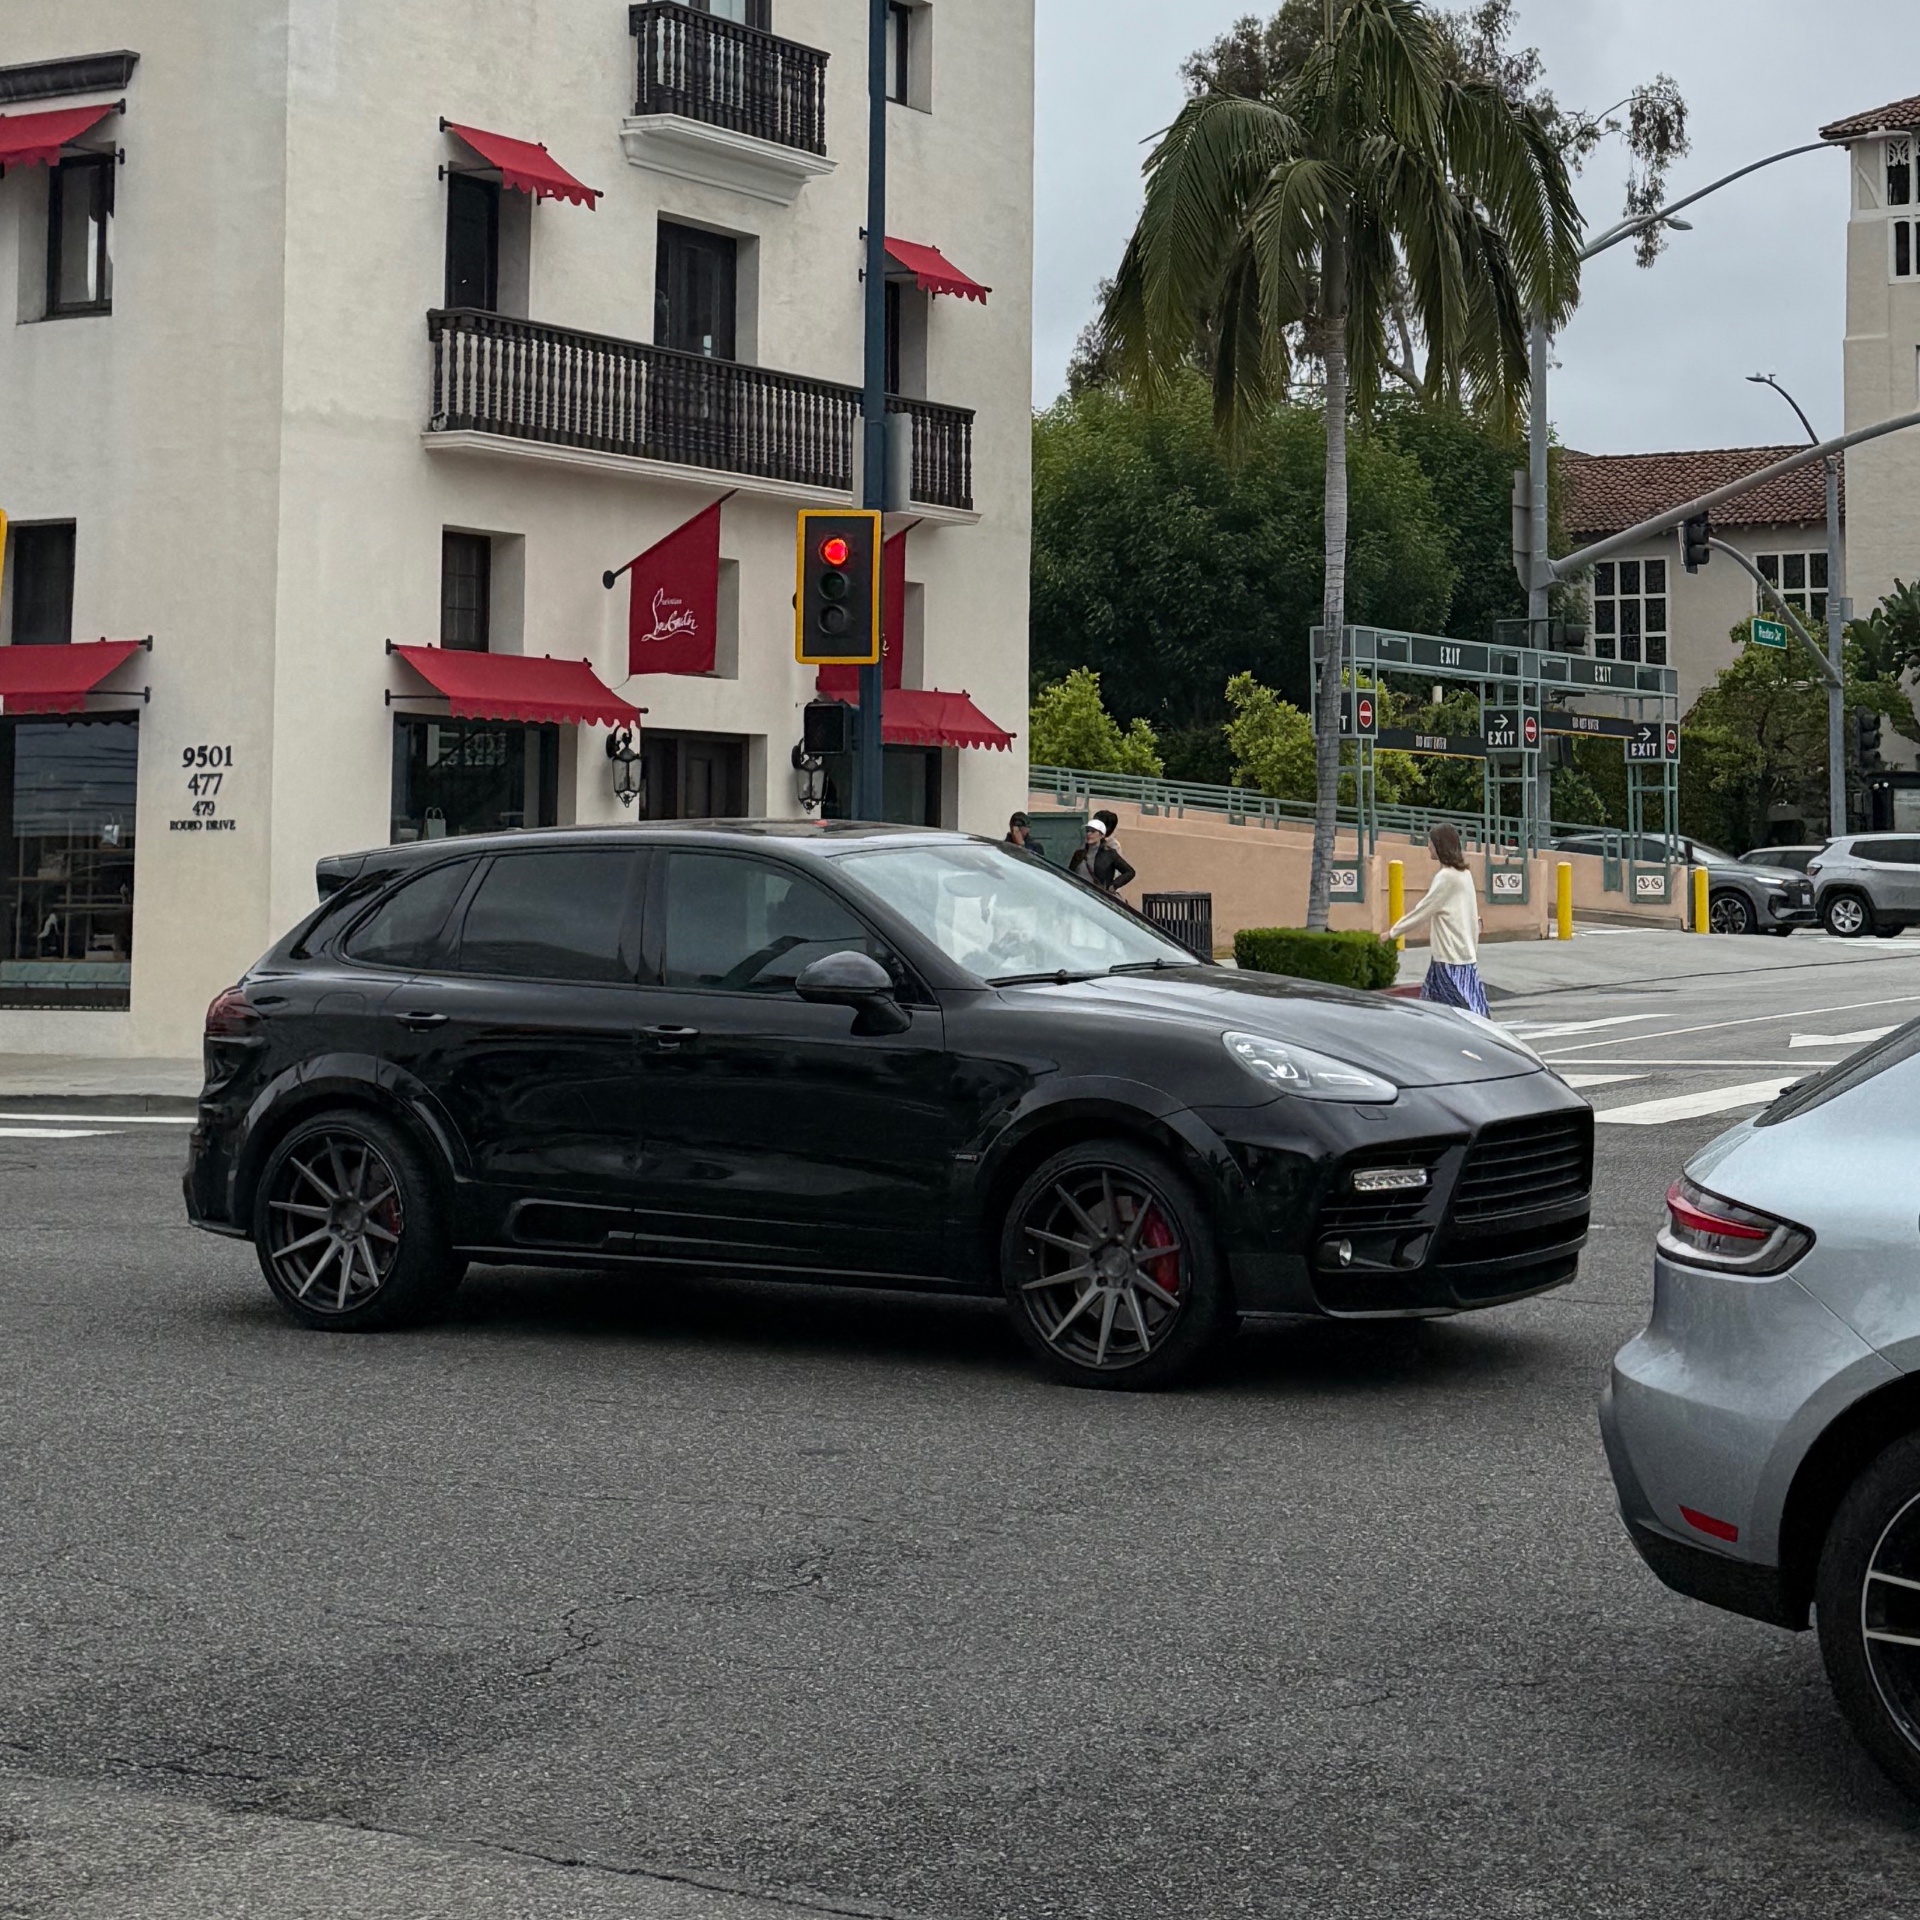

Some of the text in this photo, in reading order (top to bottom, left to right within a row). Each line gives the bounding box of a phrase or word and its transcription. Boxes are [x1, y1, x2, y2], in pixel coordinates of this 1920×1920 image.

[1440, 646, 1460, 666] EXIT
[1594, 665, 1611, 683] EXIT
[1487, 730, 1515, 746] EXIT
[181, 745, 233, 768] 9501
[1631, 742, 1657, 757] EXIT
[187, 772, 223, 796] 477
[192, 801, 215, 816] 479
[206, 819, 236, 831] DRIVE
